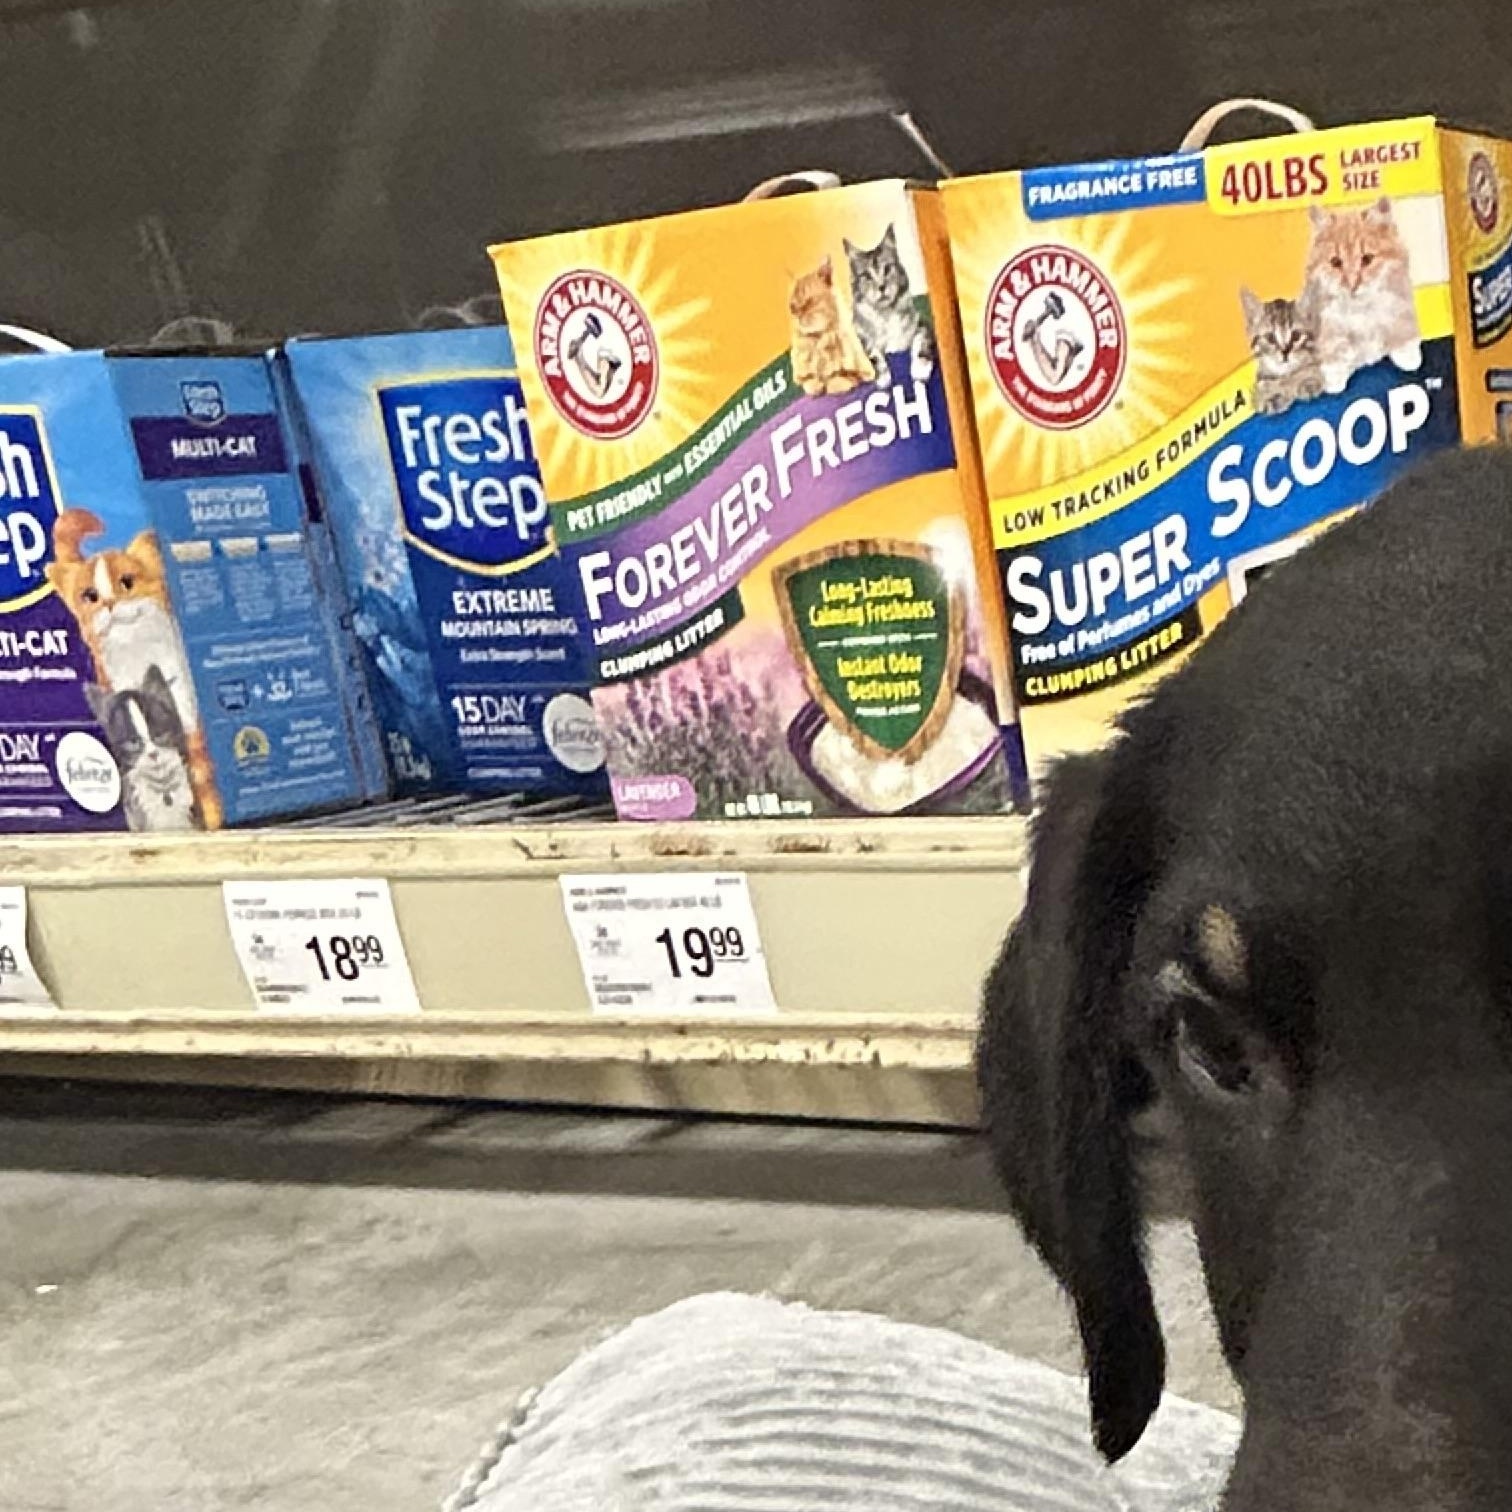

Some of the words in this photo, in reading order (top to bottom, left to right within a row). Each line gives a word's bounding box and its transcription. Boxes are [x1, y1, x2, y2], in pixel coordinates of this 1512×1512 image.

[1028, 173, 1142, 206] FRAGRANCE
[1146, 166, 1198, 190] FREE
[1221, 153, 1328, 204] 40LBS
[1341, 141, 1421, 168] LARGEST
[1343, 170, 1380, 192] SIZE
[551, 294, 573, 319] &
[569, 277, 651, 365] HAMMER
[993, 289, 1018, 360] ARM
[1010, 269, 1031, 297] &
[1030, 255, 1118, 348] HAMMER
[540, 310, 563, 377] ARM
[396, 395, 530, 468] Fresh
[567, 505, 594, 532] PET
[596, 473, 663, 523] FRIENDLY
[684, 399, 754, 478] ESSENTIAL
[753, 369, 788, 410] OILS
[1003, 506, 1046, 534] LOW
[1051, 460, 1150, 519] TRACKING
[1156, 390, 1247, 472] FORMULA
[418, 470, 547, 539] Step
[579, 464, 774, 620] FOREVER
[771, 382, 934, 498] FRESH
[1007, 514, 1191, 635] SUPER
[1207, 383, 1431, 537] SCOOP
[452, 588, 555, 615] EXTREME
[821, 575, 914, 601] Long-Lasting
[0, 630, 68, 656] TI-CAT
[441, 620, 521, 638] MOUNTAIN
[600, 640, 674, 677] CLUMPING
[675, 608, 724, 652] LITTER
[1025, 657, 1118, 697] CLUMPING
[1120, 621, 1183, 670] LITTER
